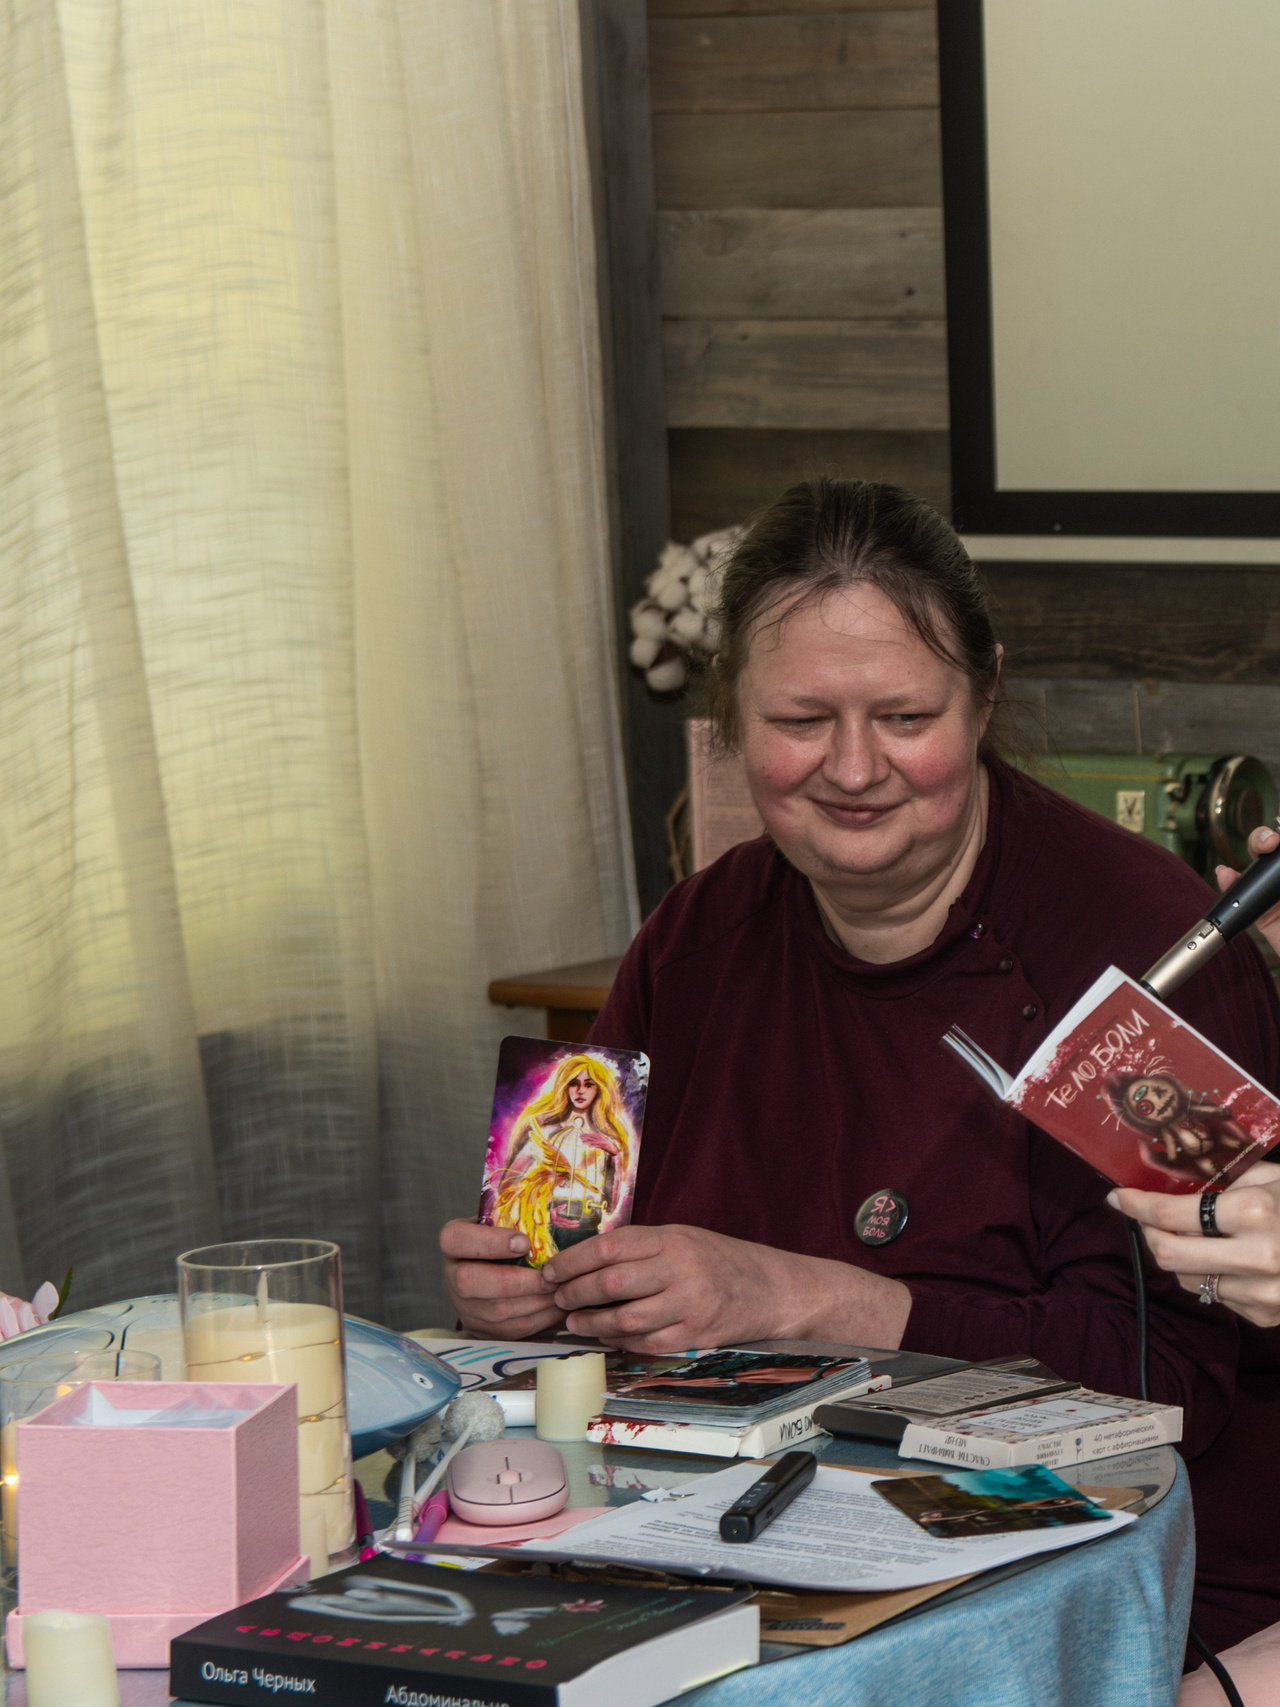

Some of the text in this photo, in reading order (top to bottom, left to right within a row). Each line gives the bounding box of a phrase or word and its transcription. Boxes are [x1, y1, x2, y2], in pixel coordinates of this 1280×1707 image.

[1089, 1008, 1150, 1066] БОЛИ
[871, 1196, 888, 1214] Я
[867, 1214, 890, 1226] МОЯ
[862, 1226, 886, 1238] БОЛЬ
[1103, 1424, 1155, 1440] метафорических
[944, 1435, 968, 1448] МЕНЯ!
[1092, 1446, 1106, 1455] карт
[1112, 1435, 1159, 1451] аффирмациями
[918, 1443, 991, 1467] СЧАСТЬЕ ВЫБИРАЕТ
[201, 1661, 317, 1693] Ольга Черных
